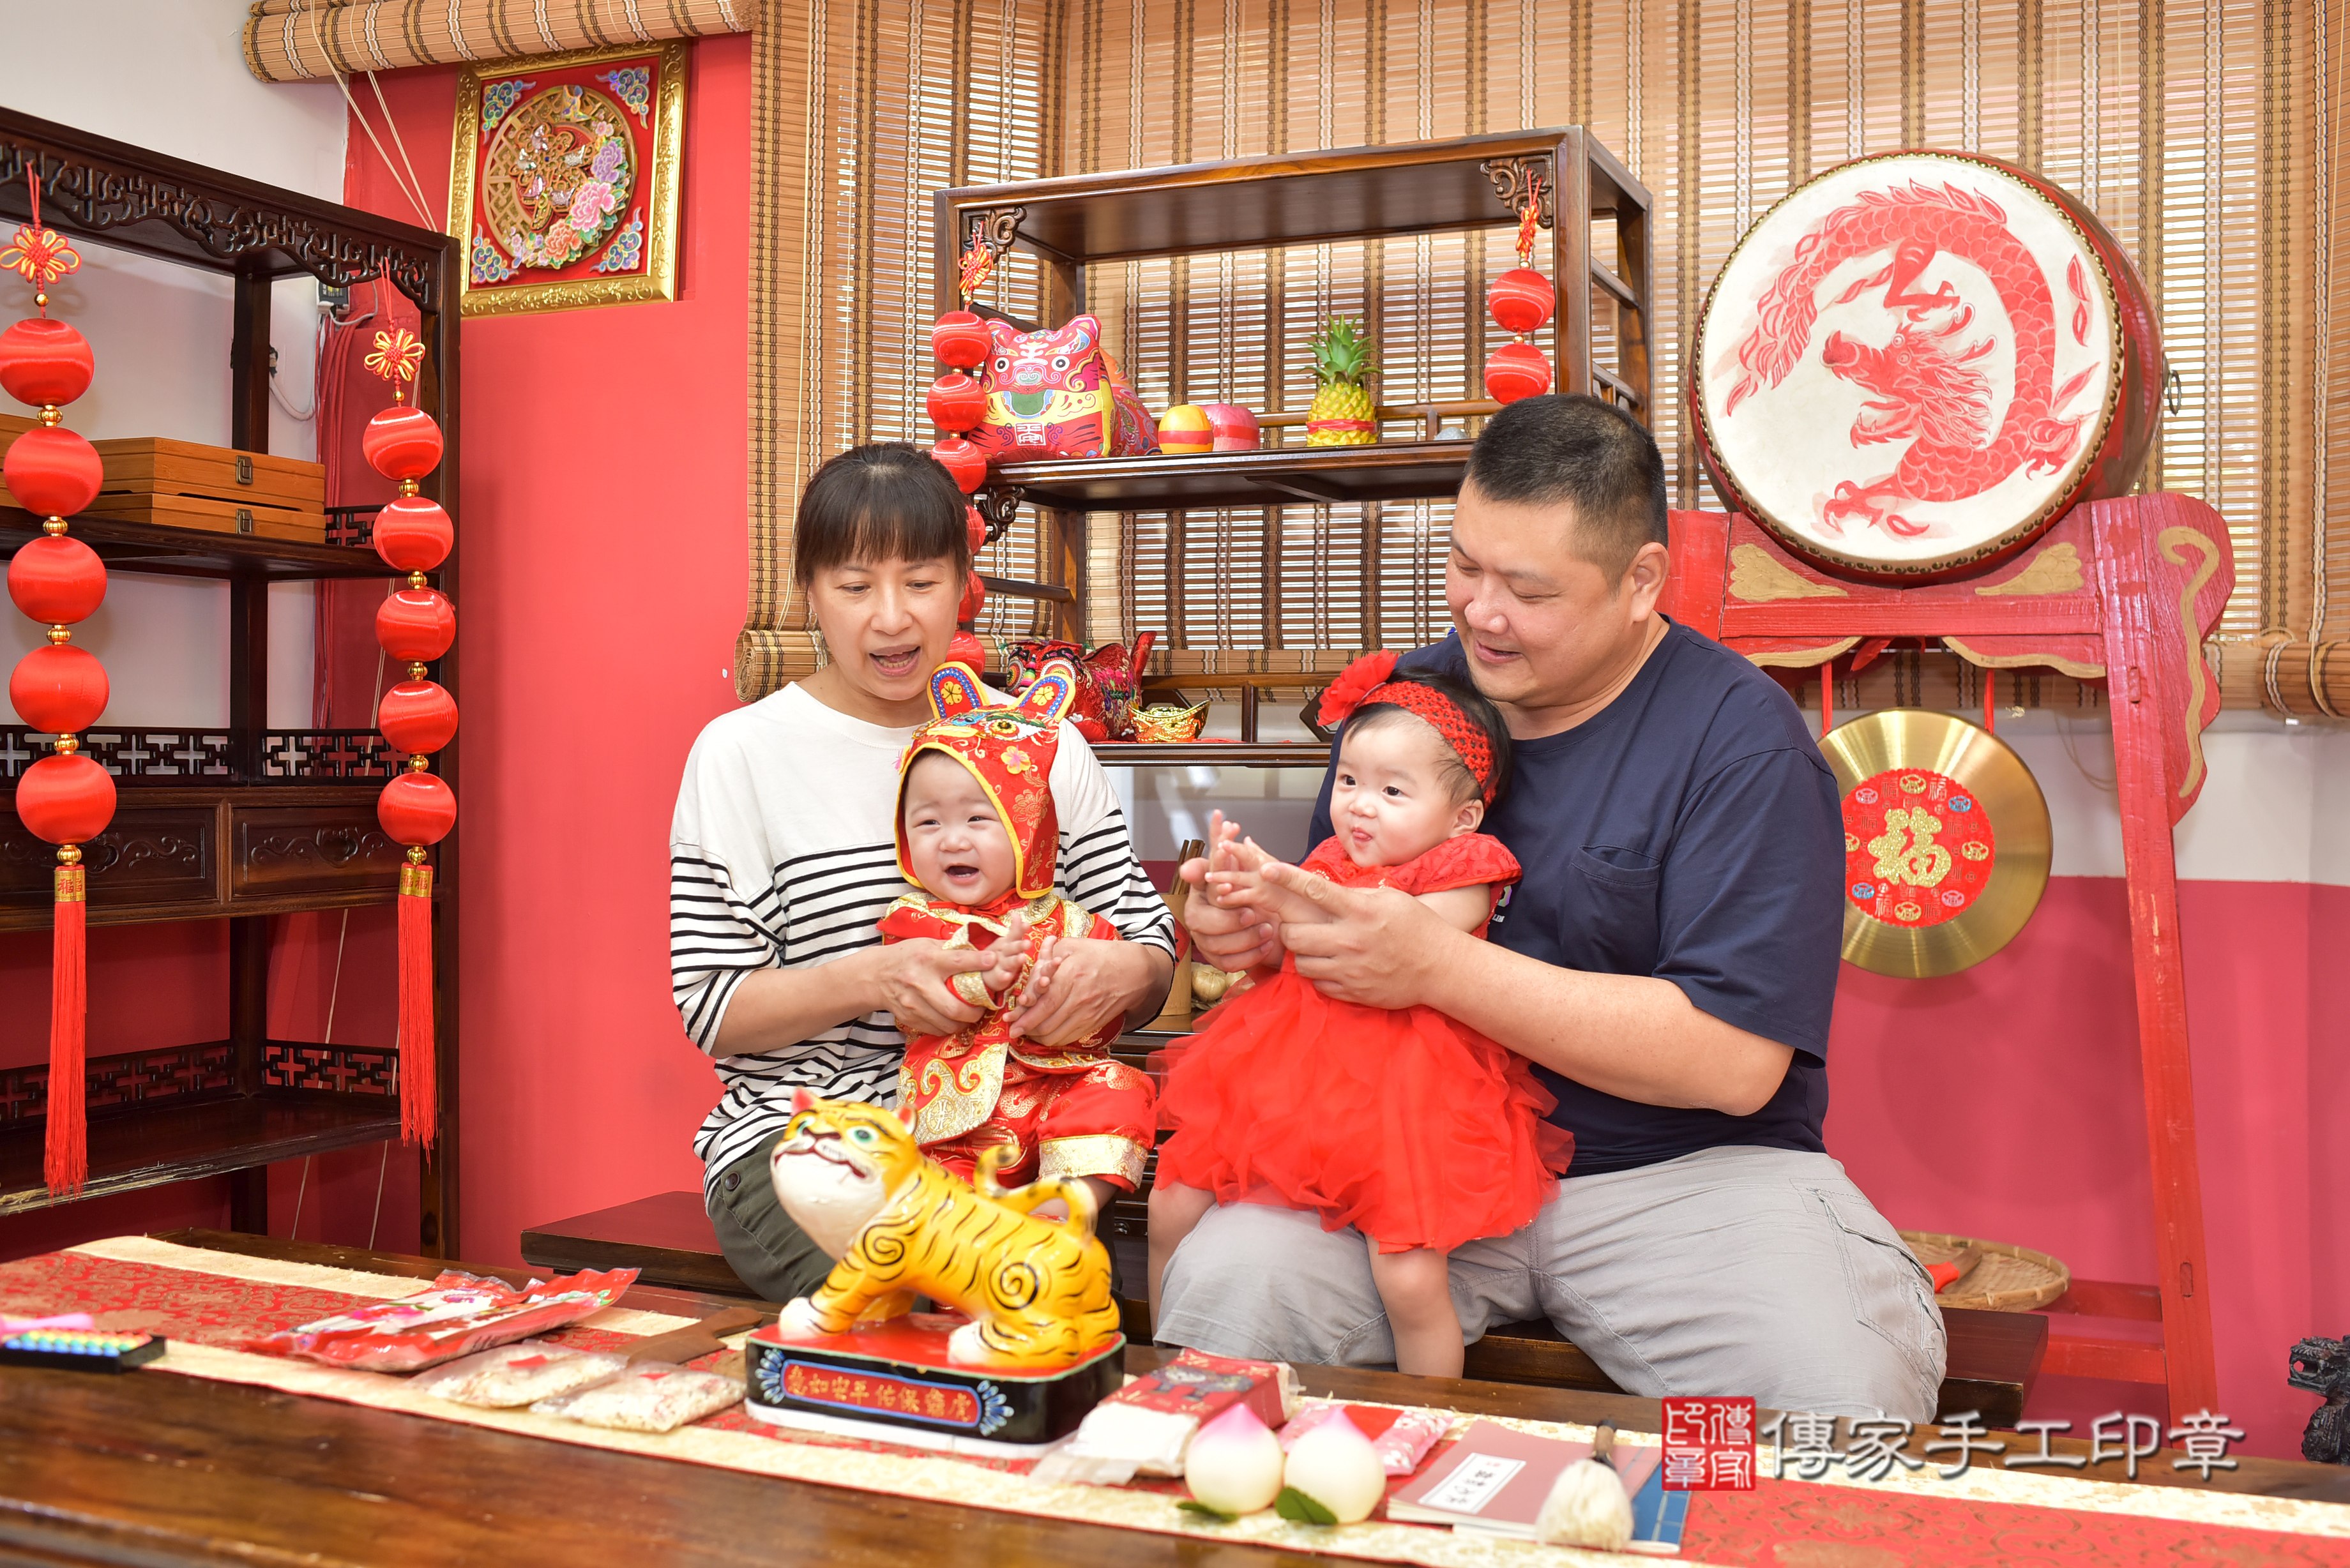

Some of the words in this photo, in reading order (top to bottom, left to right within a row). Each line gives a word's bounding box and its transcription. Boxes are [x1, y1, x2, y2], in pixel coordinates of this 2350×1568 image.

[1881, 776, 1899, 799] 福
[1928, 777, 1947, 801] 福
[1867, 806, 1952, 887] 福
[1875, 894, 1893, 918] 福
[1923, 897, 1942, 920] 福
